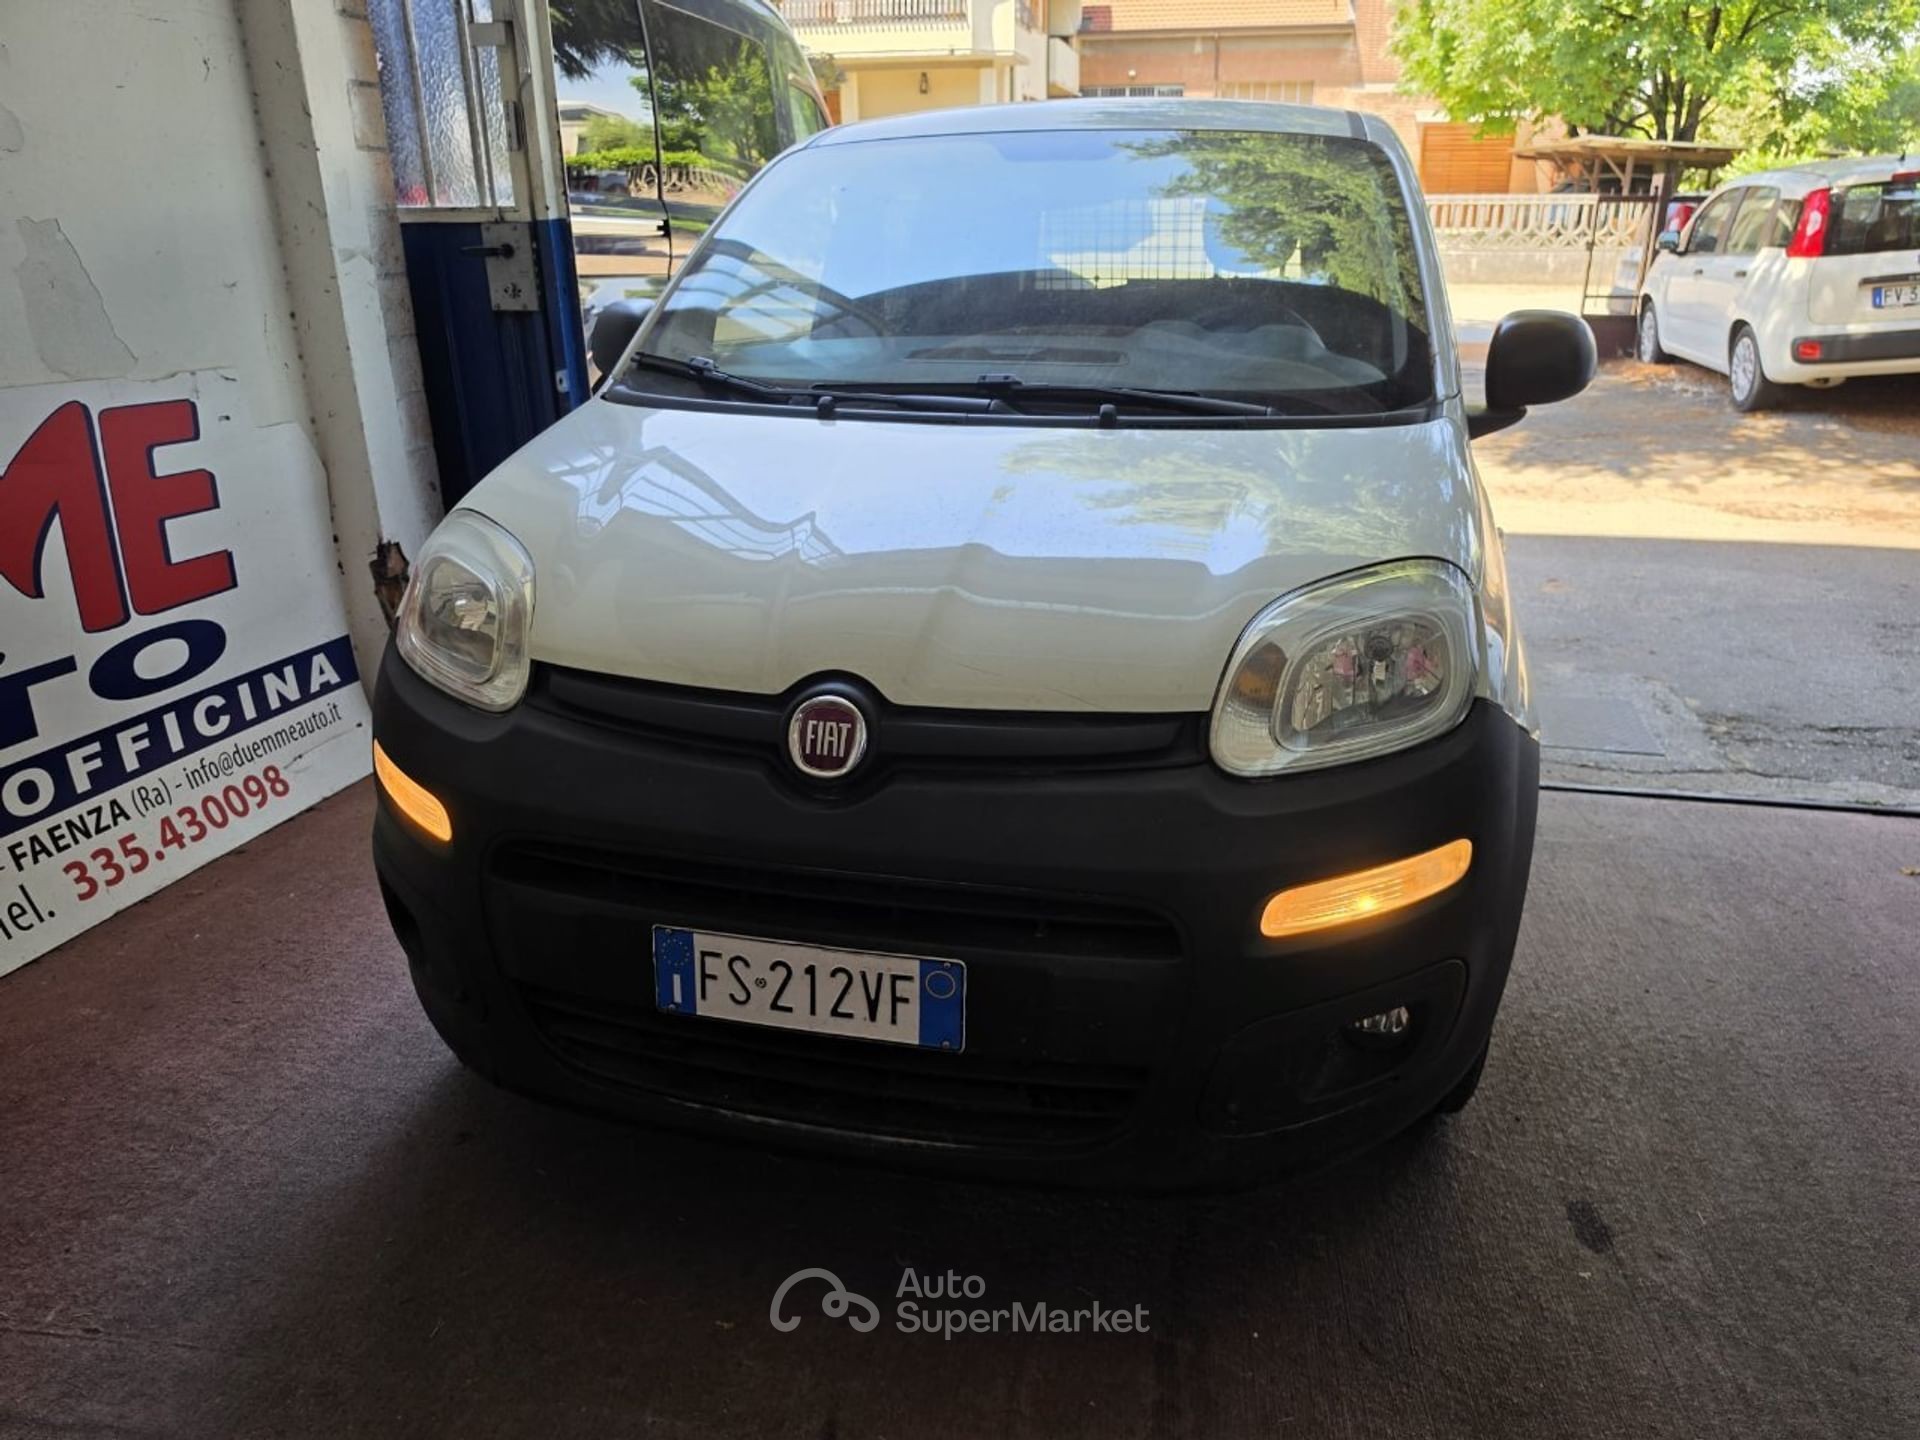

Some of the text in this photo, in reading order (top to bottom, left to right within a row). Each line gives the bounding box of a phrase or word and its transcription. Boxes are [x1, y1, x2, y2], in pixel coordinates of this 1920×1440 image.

[1, 652, 341, 818] OFFICINA
[8, 798, 131, 872] FAENZA
[130, 778, 173, 817] (Ra)
[184, 702, 342, 790] info@duemmeauto.it
[805, 720, 852, 758] FIAT
[62, 764, 291, 901] 335.430098
